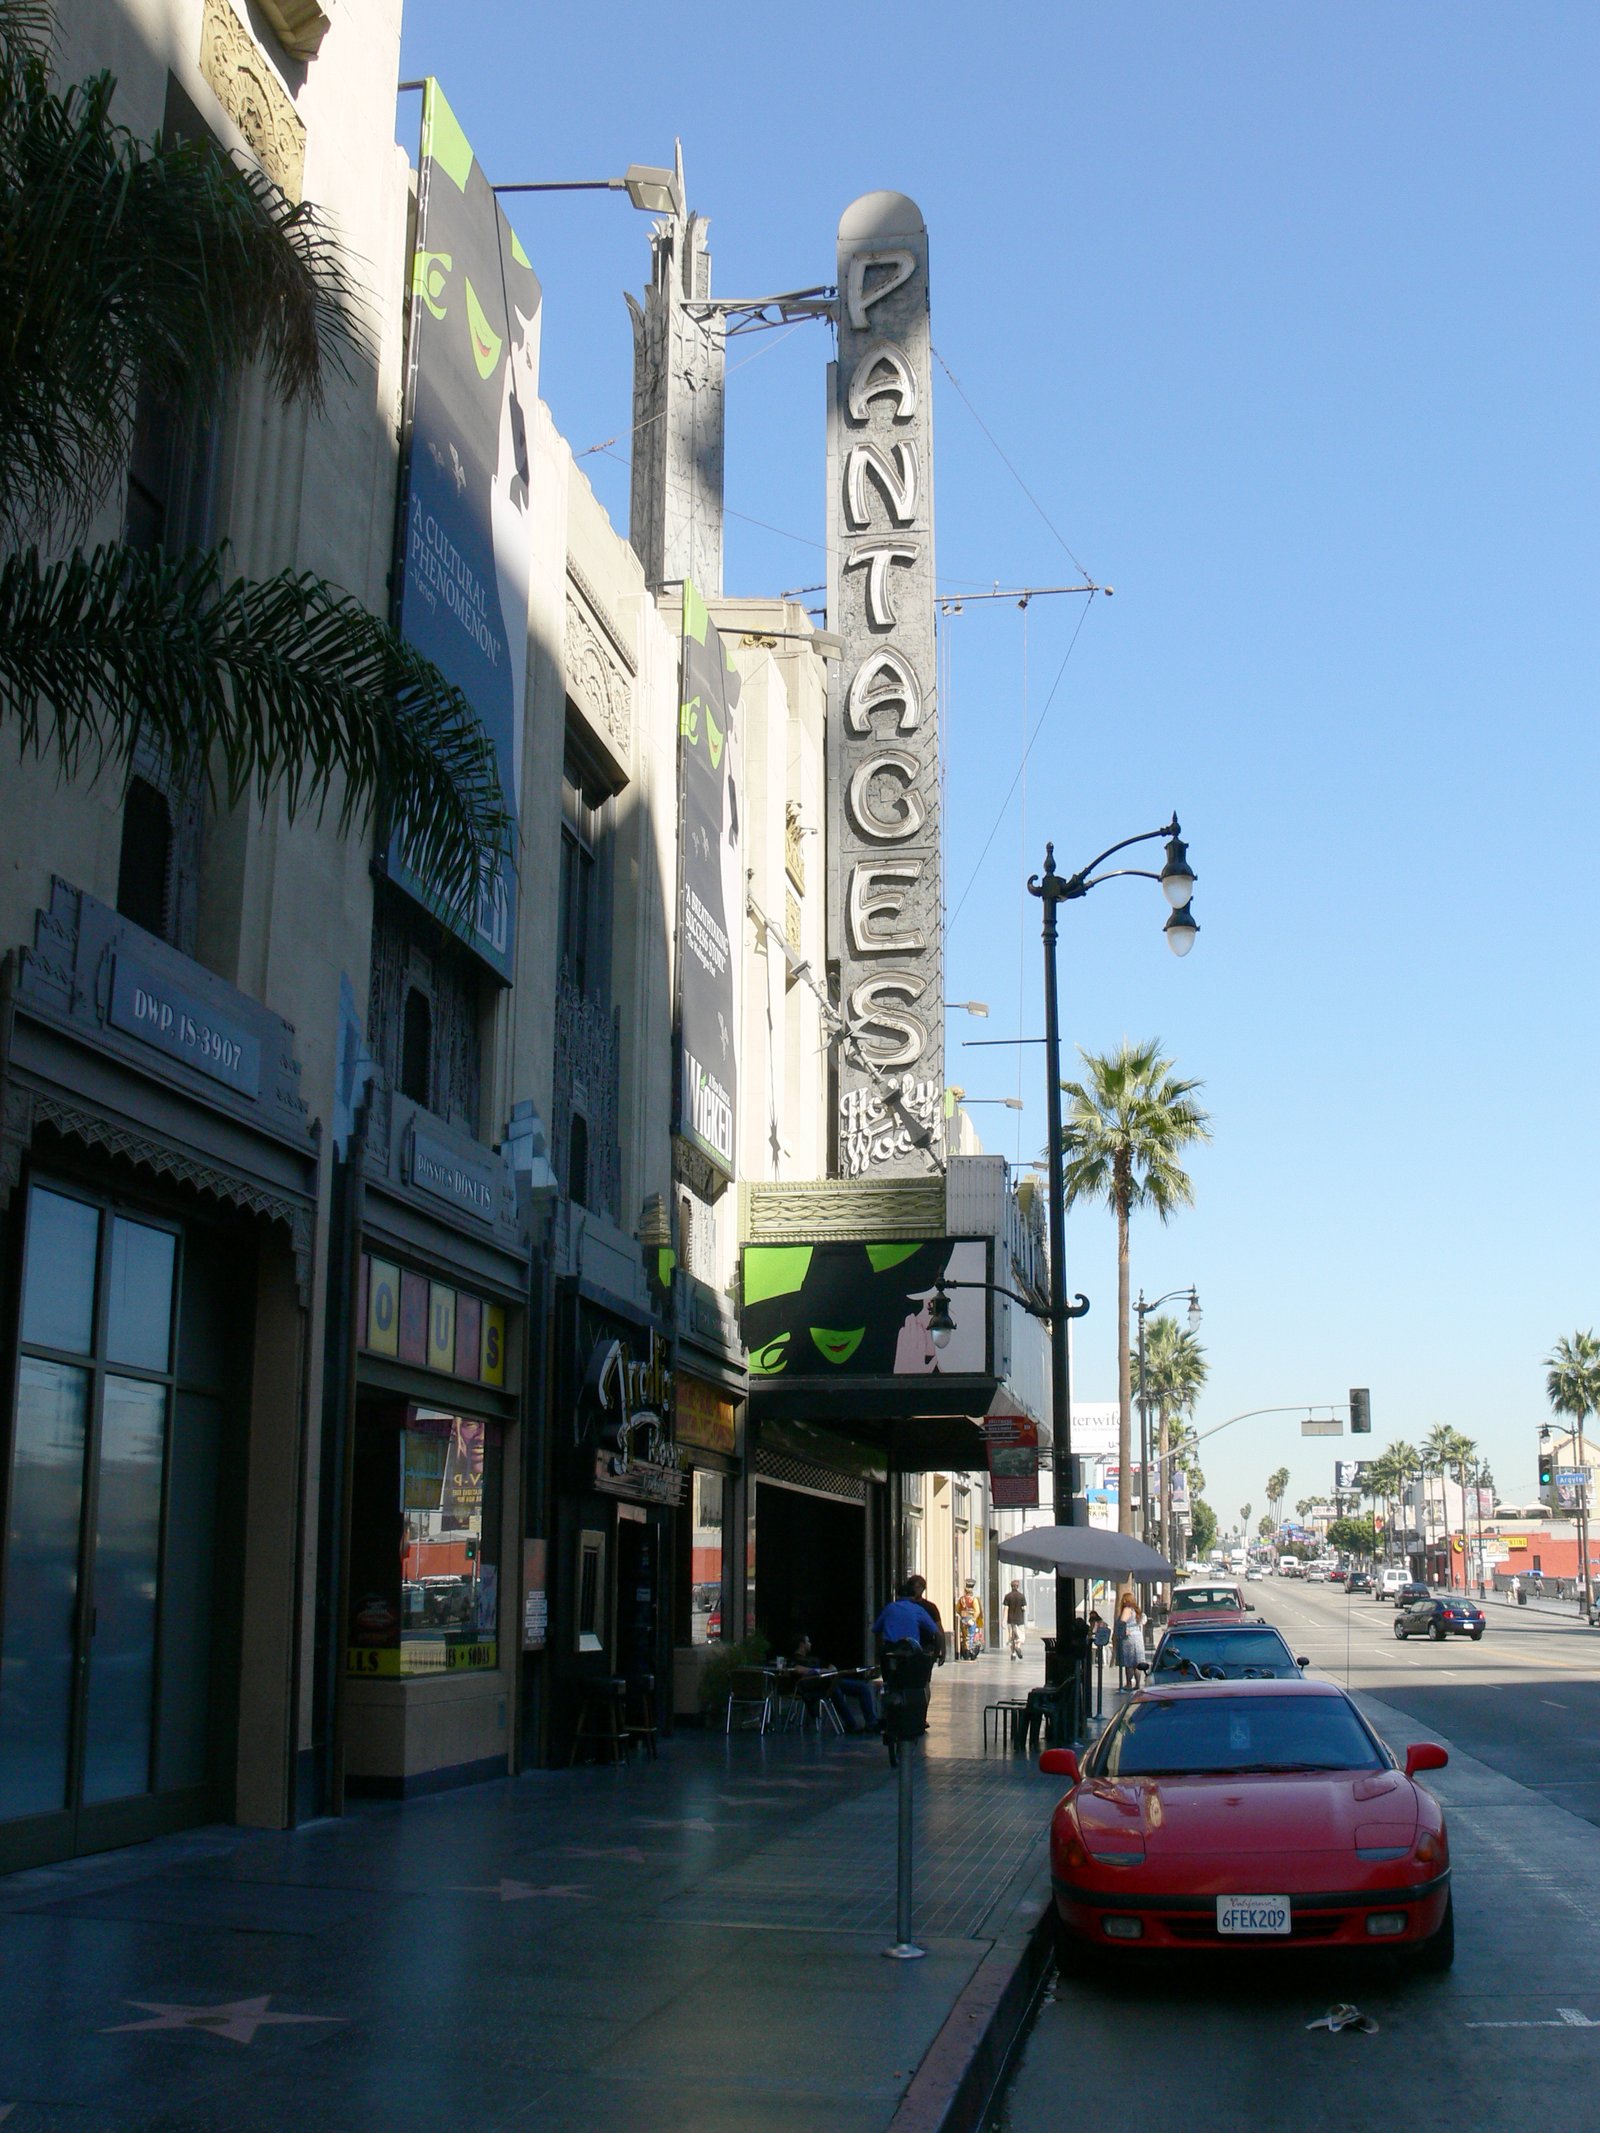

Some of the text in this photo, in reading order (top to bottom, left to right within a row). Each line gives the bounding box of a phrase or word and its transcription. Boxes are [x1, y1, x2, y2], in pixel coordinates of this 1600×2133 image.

[425, 516, 487, 619] CULTURAL
[848, 250, 928, 1066] PANTAGES
[685, 907, 708, 952] SUCCESS
[455, 1170, 492, 1210] DONUTS
[1222, 1910, 1286, 1928] 6FEK209
